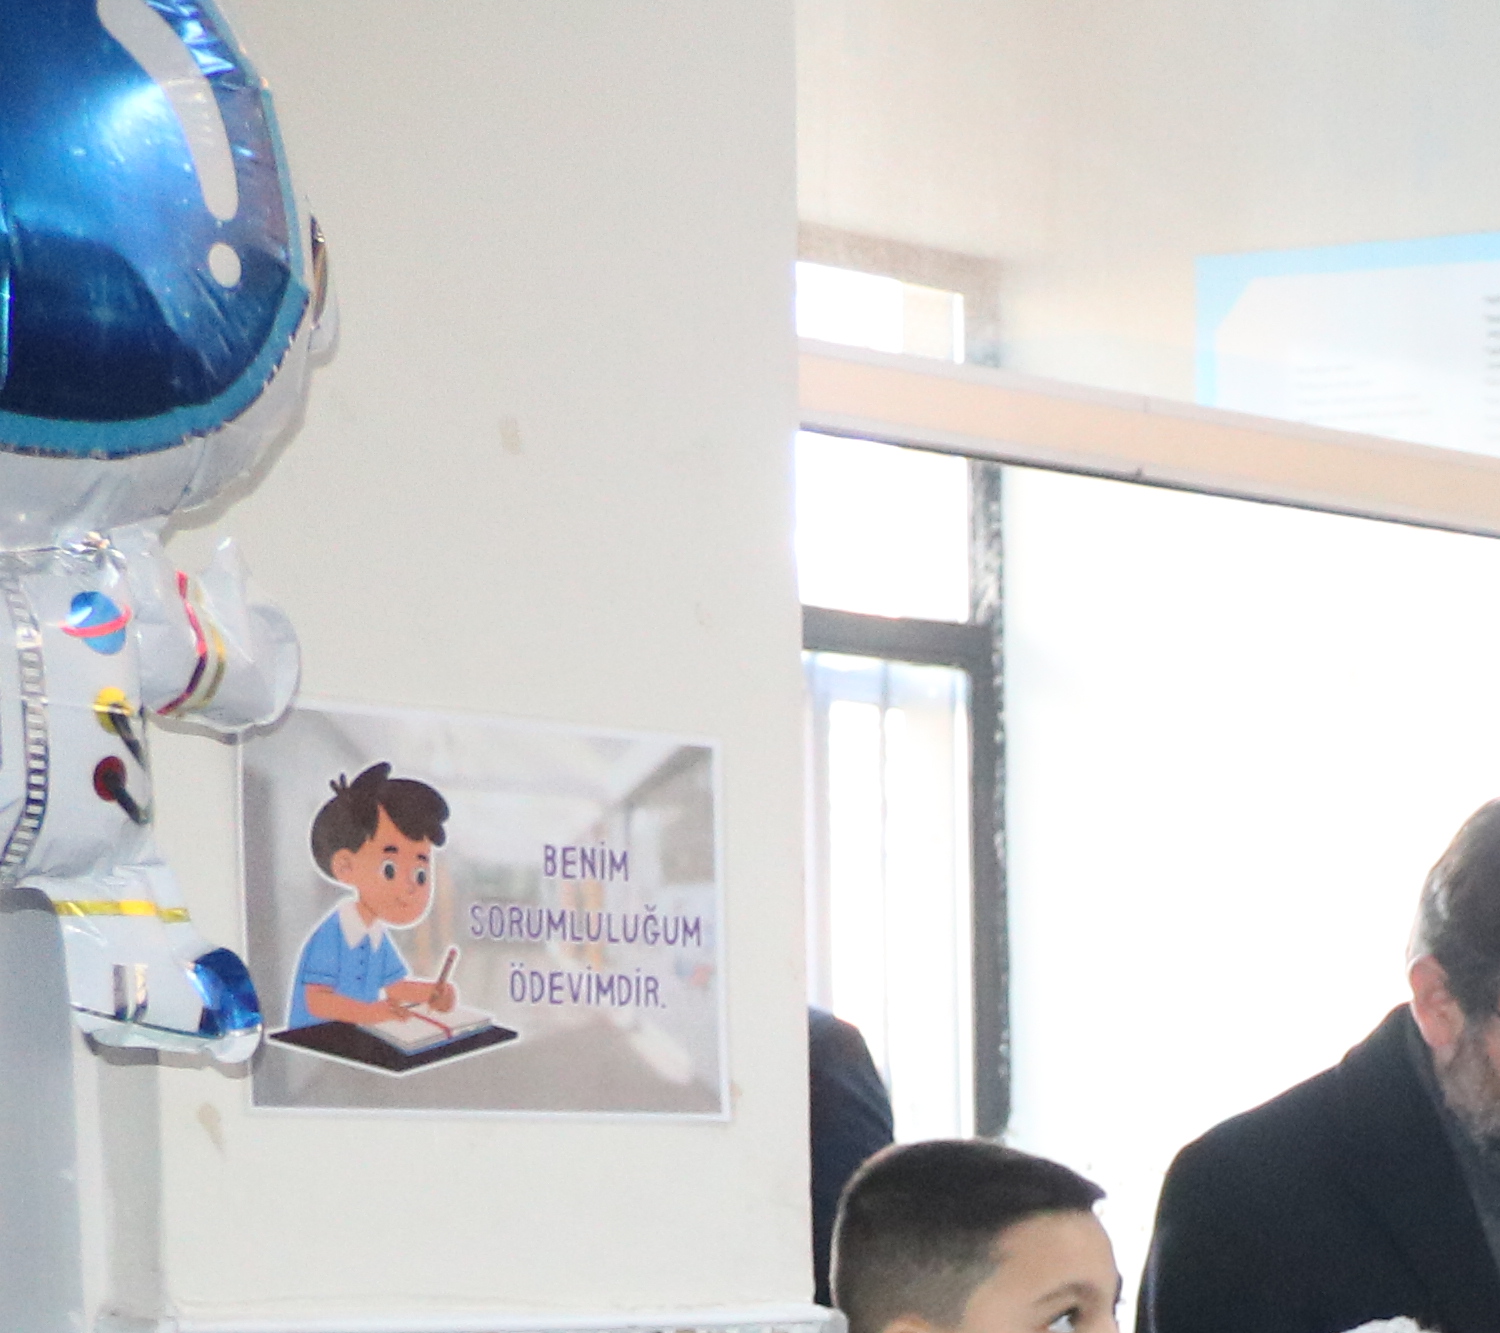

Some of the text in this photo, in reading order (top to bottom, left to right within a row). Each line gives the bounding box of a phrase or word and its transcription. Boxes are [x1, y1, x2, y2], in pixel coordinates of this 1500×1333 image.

[543, 840, 630, 882] BENİM
[469, 903, 702, 948] SORUMLULUĞUM
[509, 961, 667, 1009] ÖDEVİMDİR.
